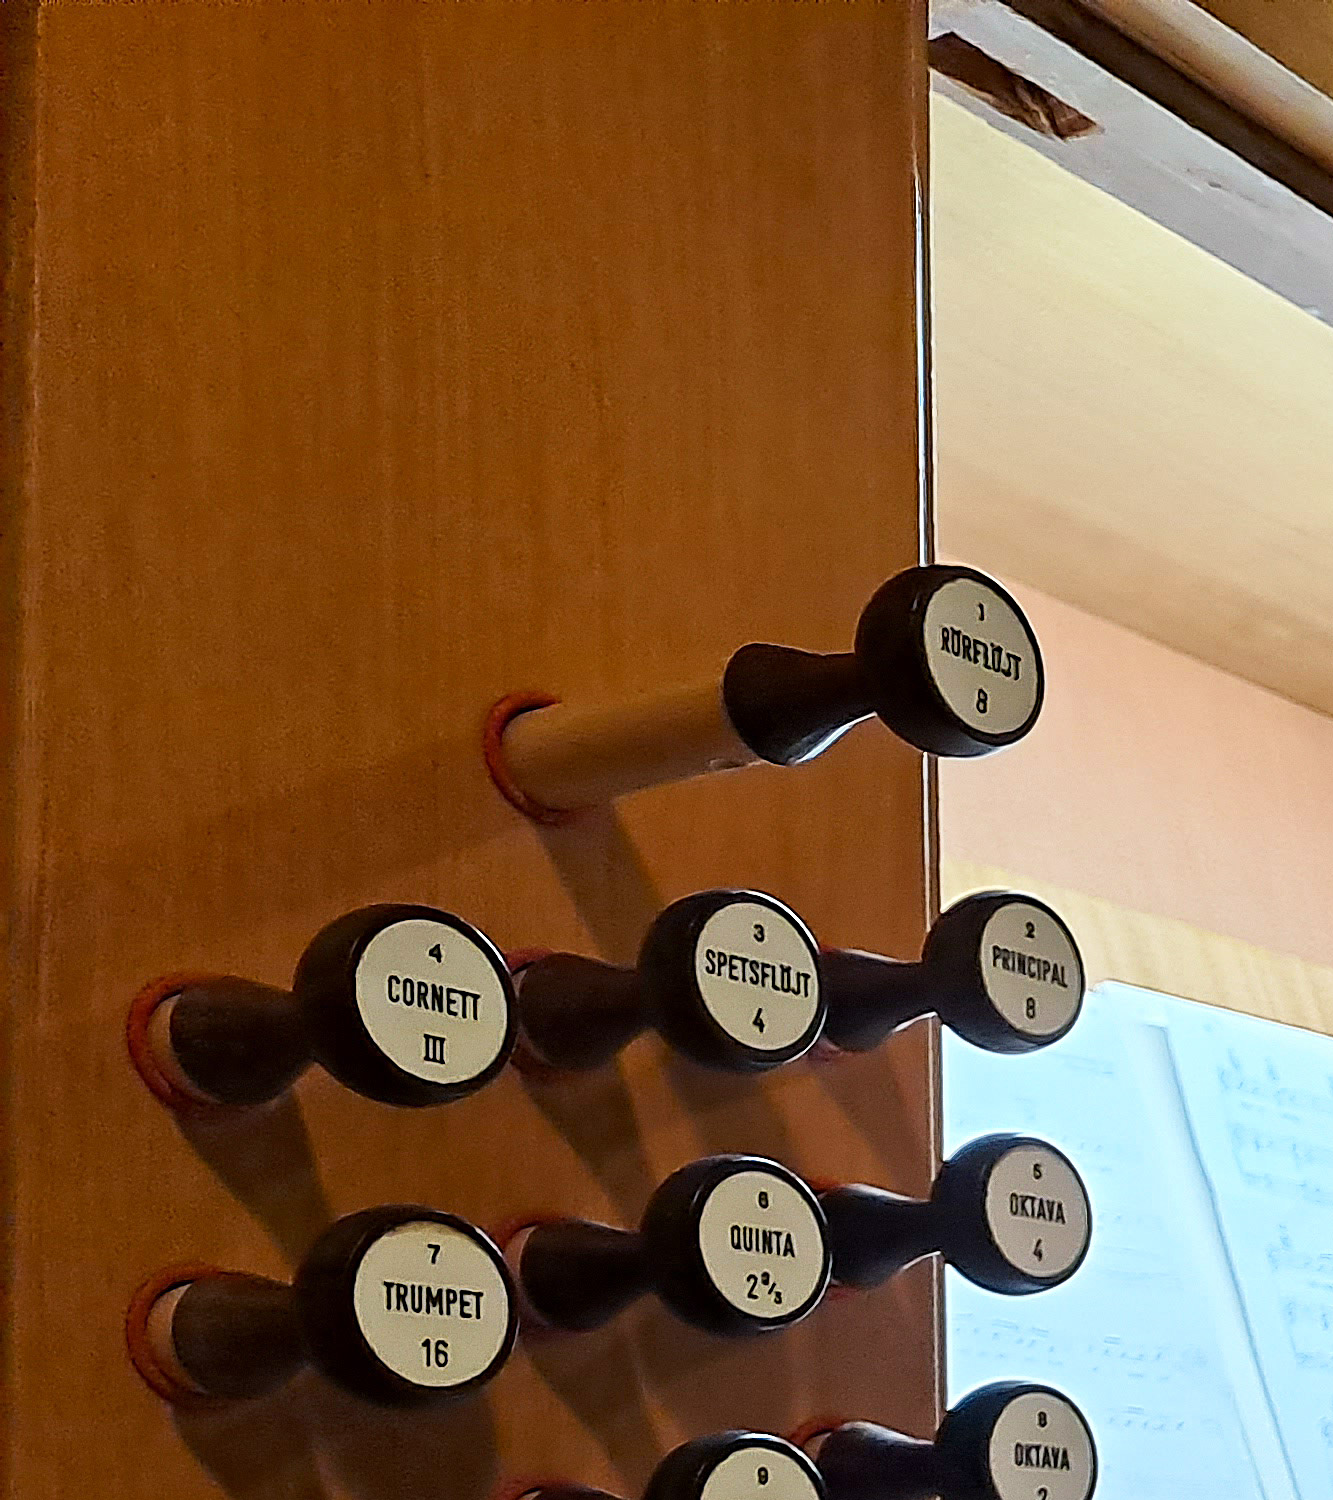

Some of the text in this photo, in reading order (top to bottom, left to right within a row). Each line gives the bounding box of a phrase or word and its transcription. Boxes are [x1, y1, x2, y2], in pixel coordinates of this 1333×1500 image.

[976, 601, 985, 622] 1
[975, 687, 989, 715] 8
[752, 923, 766, 944] 3
[1024, 921, 1036, 940] 2
[428, 943, 443, 964] 4
[991, 944, 1069, 989] PRINCIPAL
[704, 948, 812, 999] SPETSFLÖJT
[387, 974, 482, 1022] CORNETT
[1025, 996, 1037, 1020] 8
[751, 1007, 766, 1035] 4
[422, 1033, 447, 1066] III
[1008, 1192, 1067, 1226] OKTAVA
[426, 1243, 441, 1265] 7
[729, 1224, 796, 1259] QUINTA
[1032, 1238, 1044, 1263] 4
[381, 1280, 485, 1320] TRUMPET
[421, 1337, 449, 1368] 16
[1036, 1410, 1048, 1429] 8
[1014, 1441, 1071, 1472] OKTAVA
[756, 1466, 769, 1486] 9
